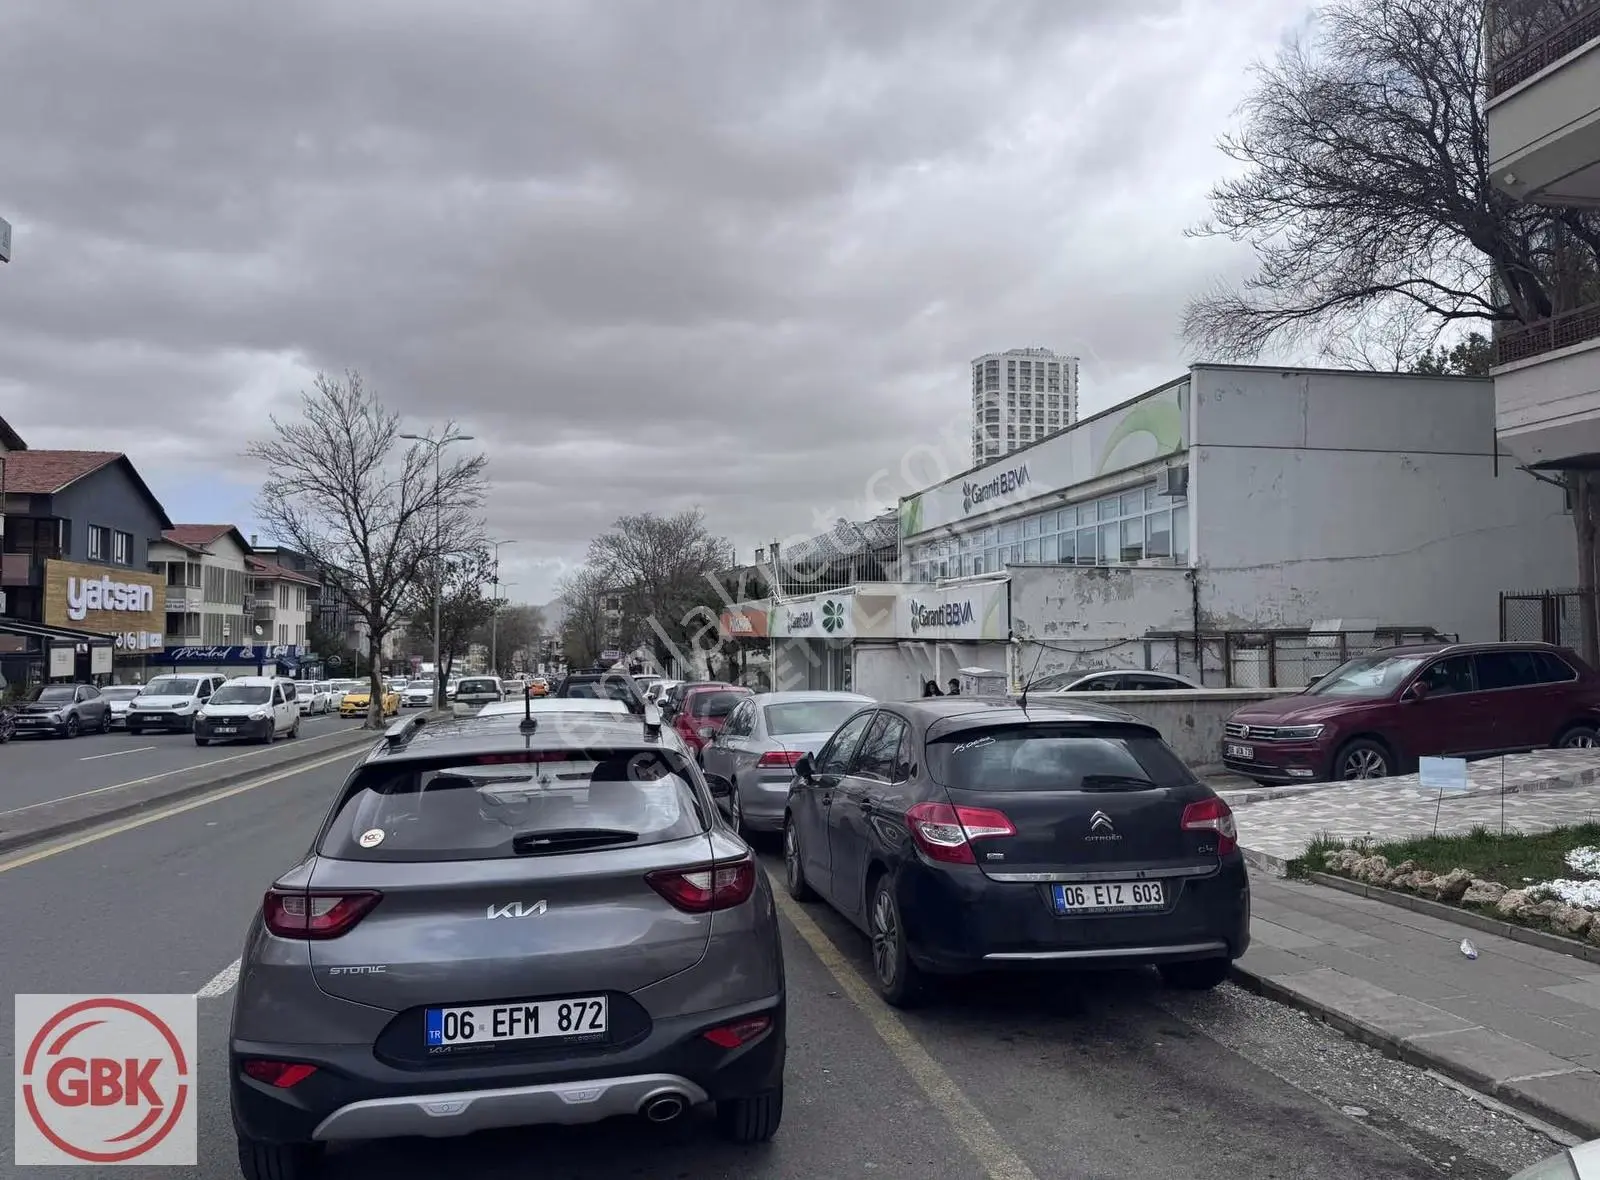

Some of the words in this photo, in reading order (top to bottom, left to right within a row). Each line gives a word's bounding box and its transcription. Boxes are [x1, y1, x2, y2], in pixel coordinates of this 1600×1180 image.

[972, 477, 1000, 504] Garanti
[1000, 463, 1031, 494] BBVA
[67, 575, 153, 620] yatsan
[919, 604, 944, 626] Garanti
[945, 600, 974, 626] BBVA
[1064, 887, 1085, 906] 06
[1093, 885, 1124, 905] EIZ
[1132, 884, 1161, 903] 603
[487, 900, 547, 920] KIA
[330, 965, 386, 975] STONIC
[429, 1030, 440, 1039] TR
[444, 1011, 474, 1041] 06
[493, 1006, 539, 1037] EFM
[557, 1001, 603, 1031] 872
